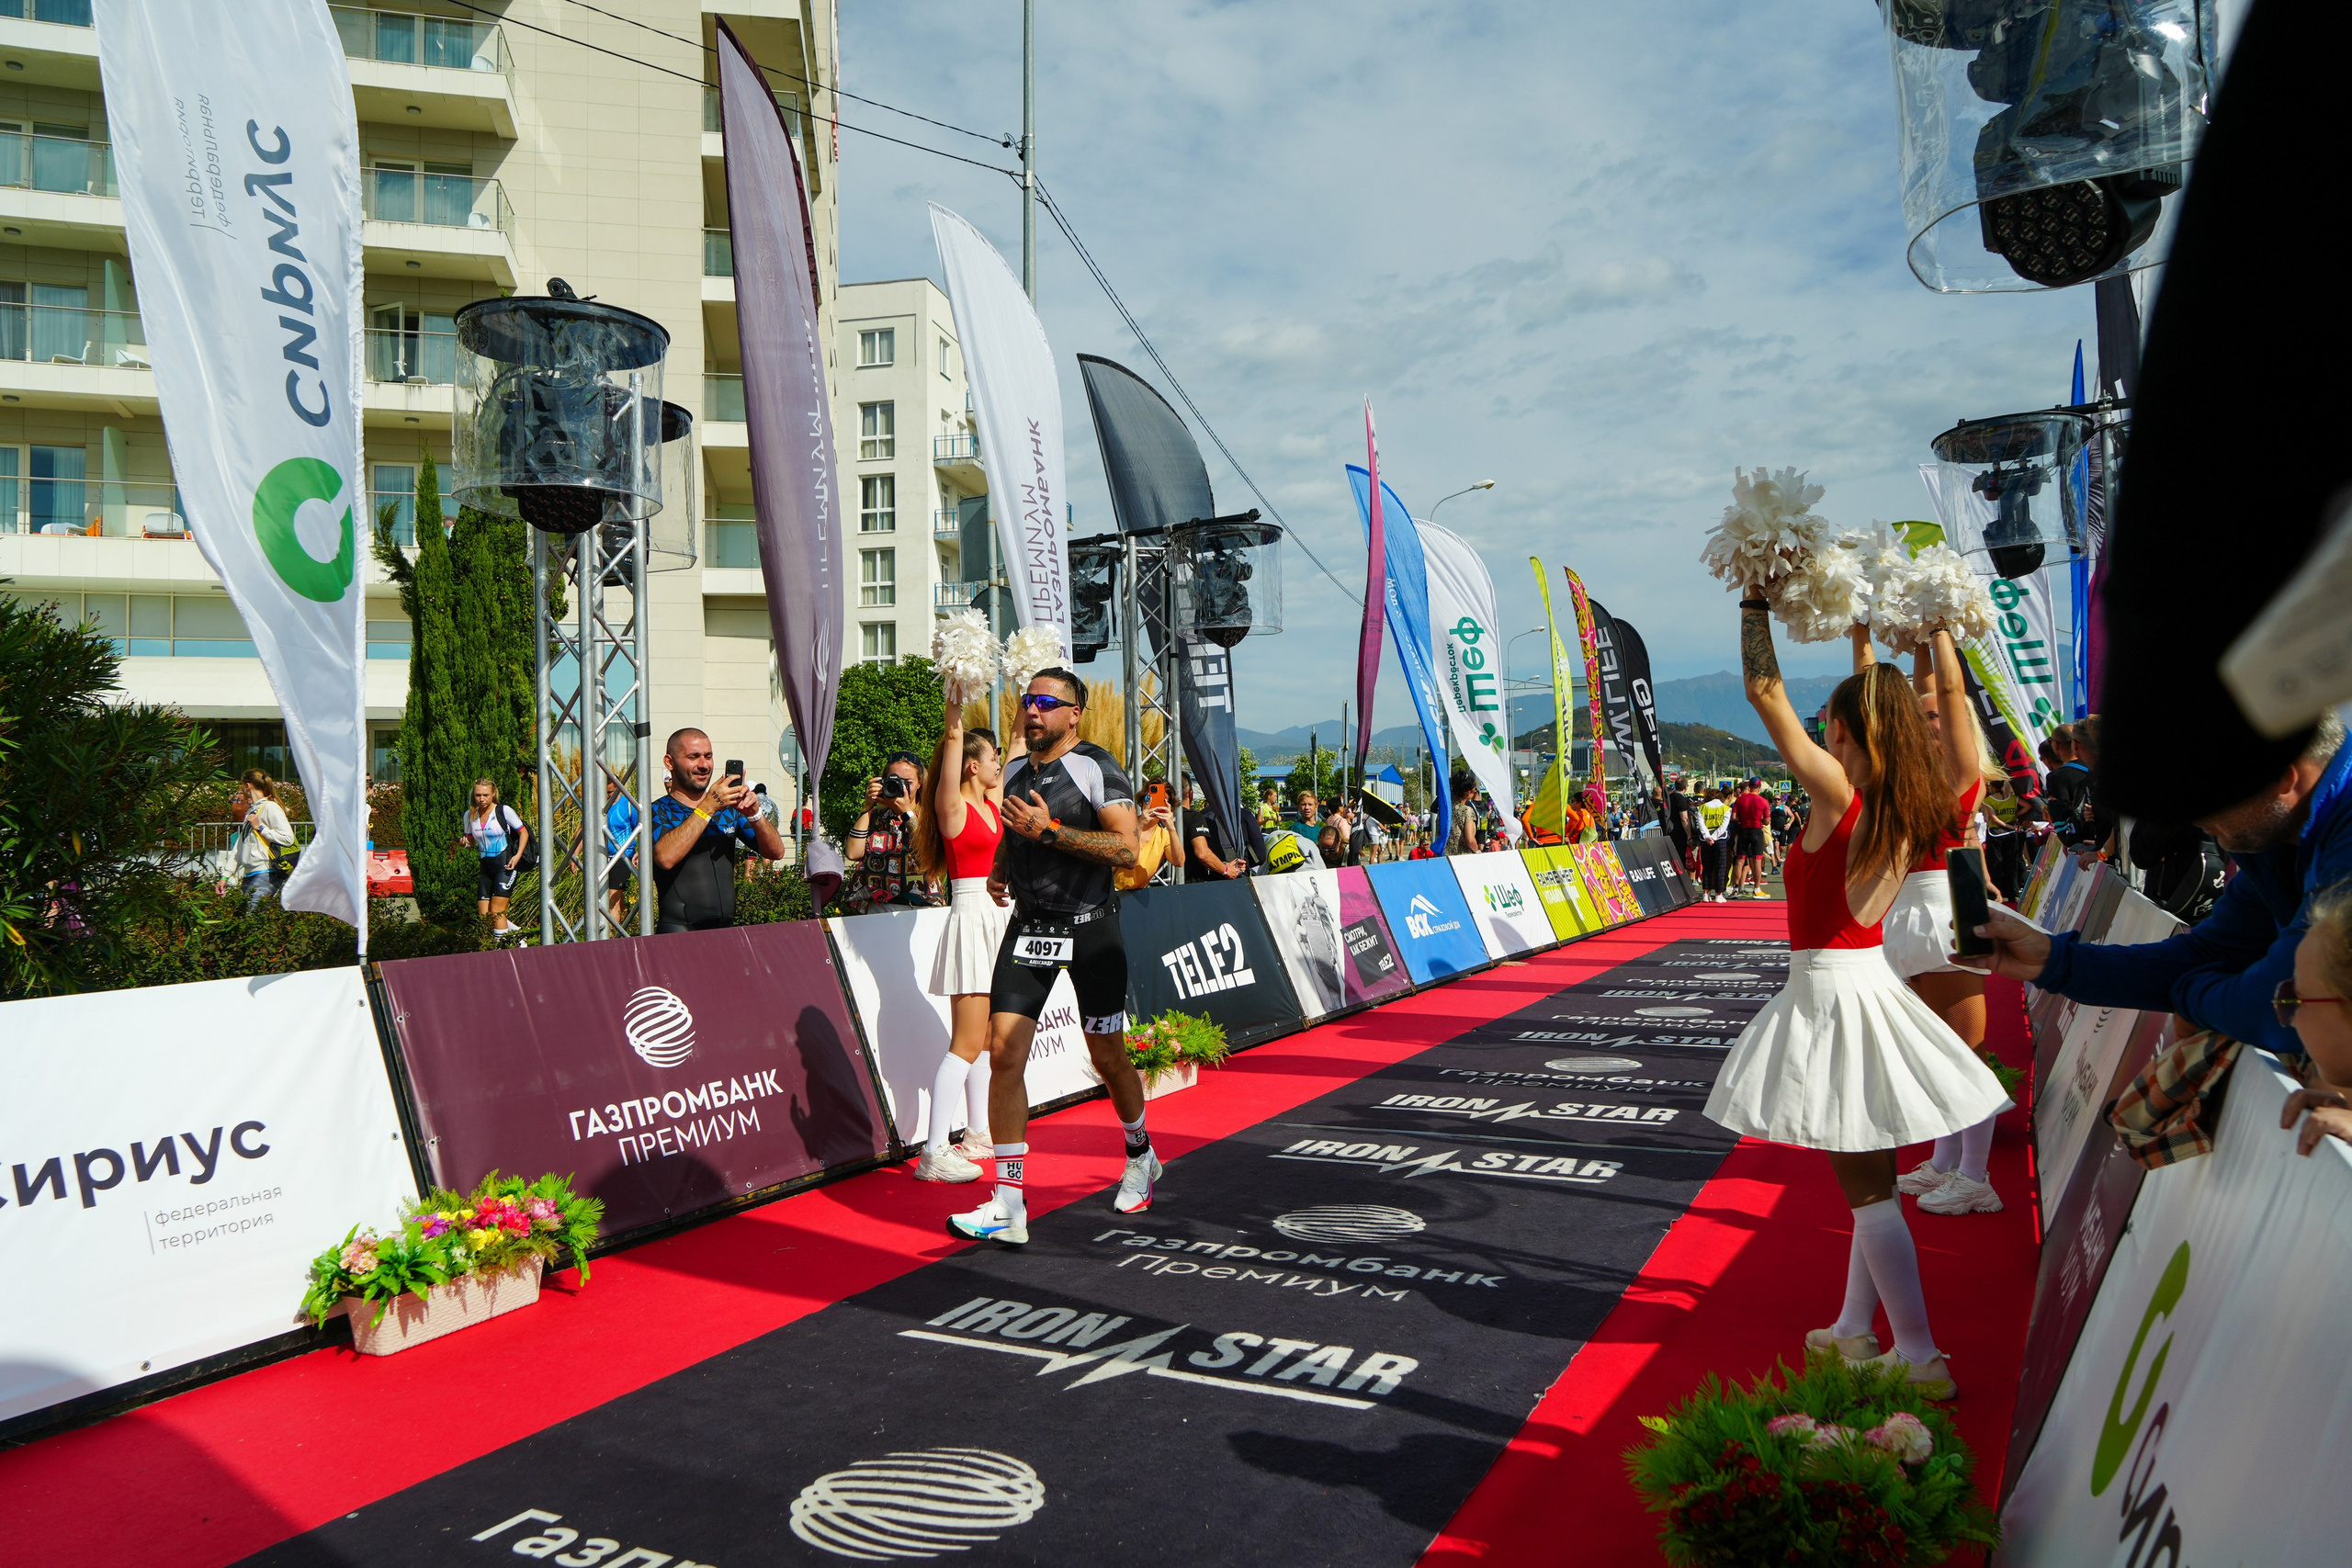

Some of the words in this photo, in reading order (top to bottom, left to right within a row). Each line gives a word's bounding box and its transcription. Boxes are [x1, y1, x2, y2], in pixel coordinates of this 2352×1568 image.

[1023, 814, 1038, 835] 4097
[1493, 883, 1525, 911] Шеф
[1405, 912, 1434, 939] ВСК
[1024, 940, 1062, 957] 4097
[1359, 934, 1378, 953] БЕЖИТ
[1160, 922, 1256, 999] TELE2
[1602, 989, 1680, 998] IRON
[1550, 1013, 1748, 1026] Газпромбан
[1513, 1031, 1611, 1043] IRON
[569, 1068, 785, 1143] ГАЗПРОМБАНК
[1379, 1092, 1501, 1113] IRON
[1547, 1102, 1679, 1122] STAR
[617, 1105, 762, 1167] ПРЕМИУМ
[0, 1120, 271, 1210] ириус
[1007, 1162, 1022, 1170] HU
[1008, 1169, 1022, 1179] GO
[1281, 1139, 1421, 1162] IRON
[1472, 1152, 1624, 1179] STAR
[154, 1186, 283, 1228] федеральная
[158, 1212, 275, 1249] территория
[1093, 1228, 1508, 1290] Газпромбанк
[1116, 1253, 1410, 1303] Премиум
[926, 1297, 1131, 1348] IRON
[1188, 1331, 1419, 1395] STAR
